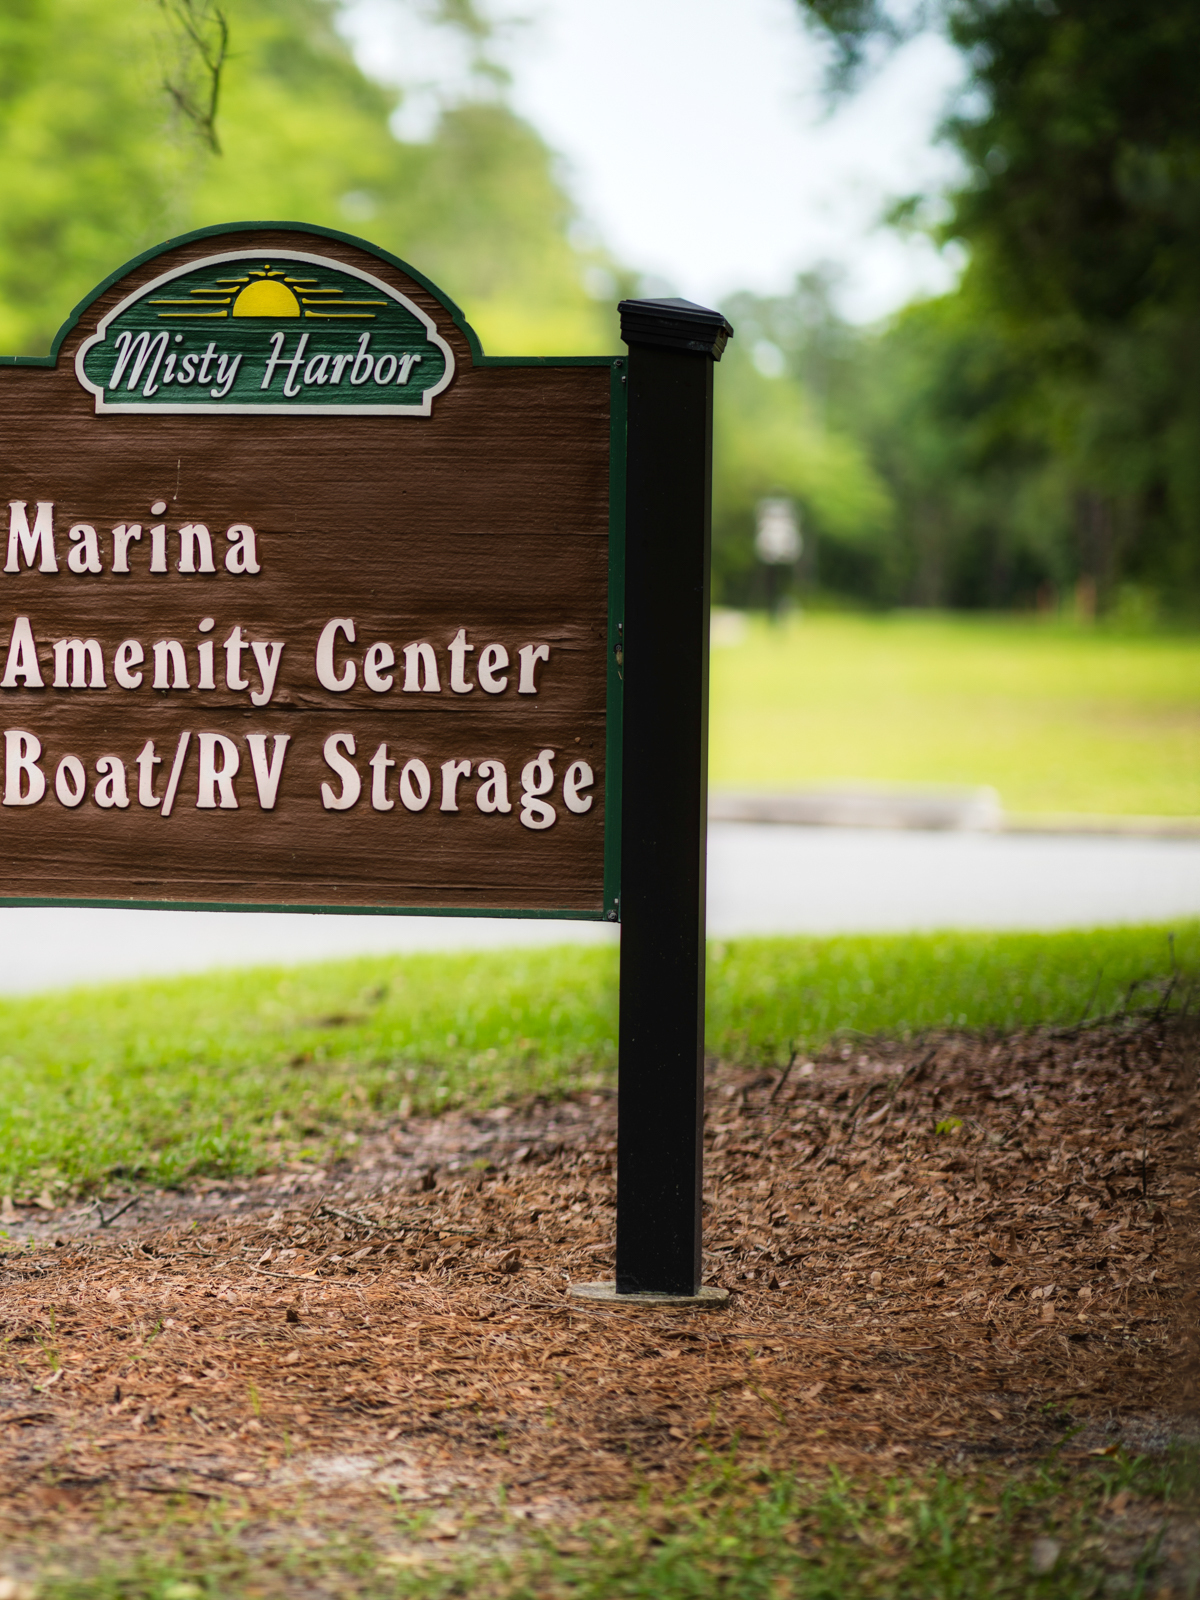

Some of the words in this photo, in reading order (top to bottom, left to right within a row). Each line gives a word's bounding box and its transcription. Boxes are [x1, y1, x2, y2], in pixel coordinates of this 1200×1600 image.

[108, 331, 243, 398] Misty
[260, 331, 422, 397] Harbor
[2, 501, 261, 575] Marina
[0, 616, 285, 707] Amenity
[314, 617, 550, 694] Center
[1, 730, 291, 817] Boat/RV
[320, 733, 596, 830] Storage
